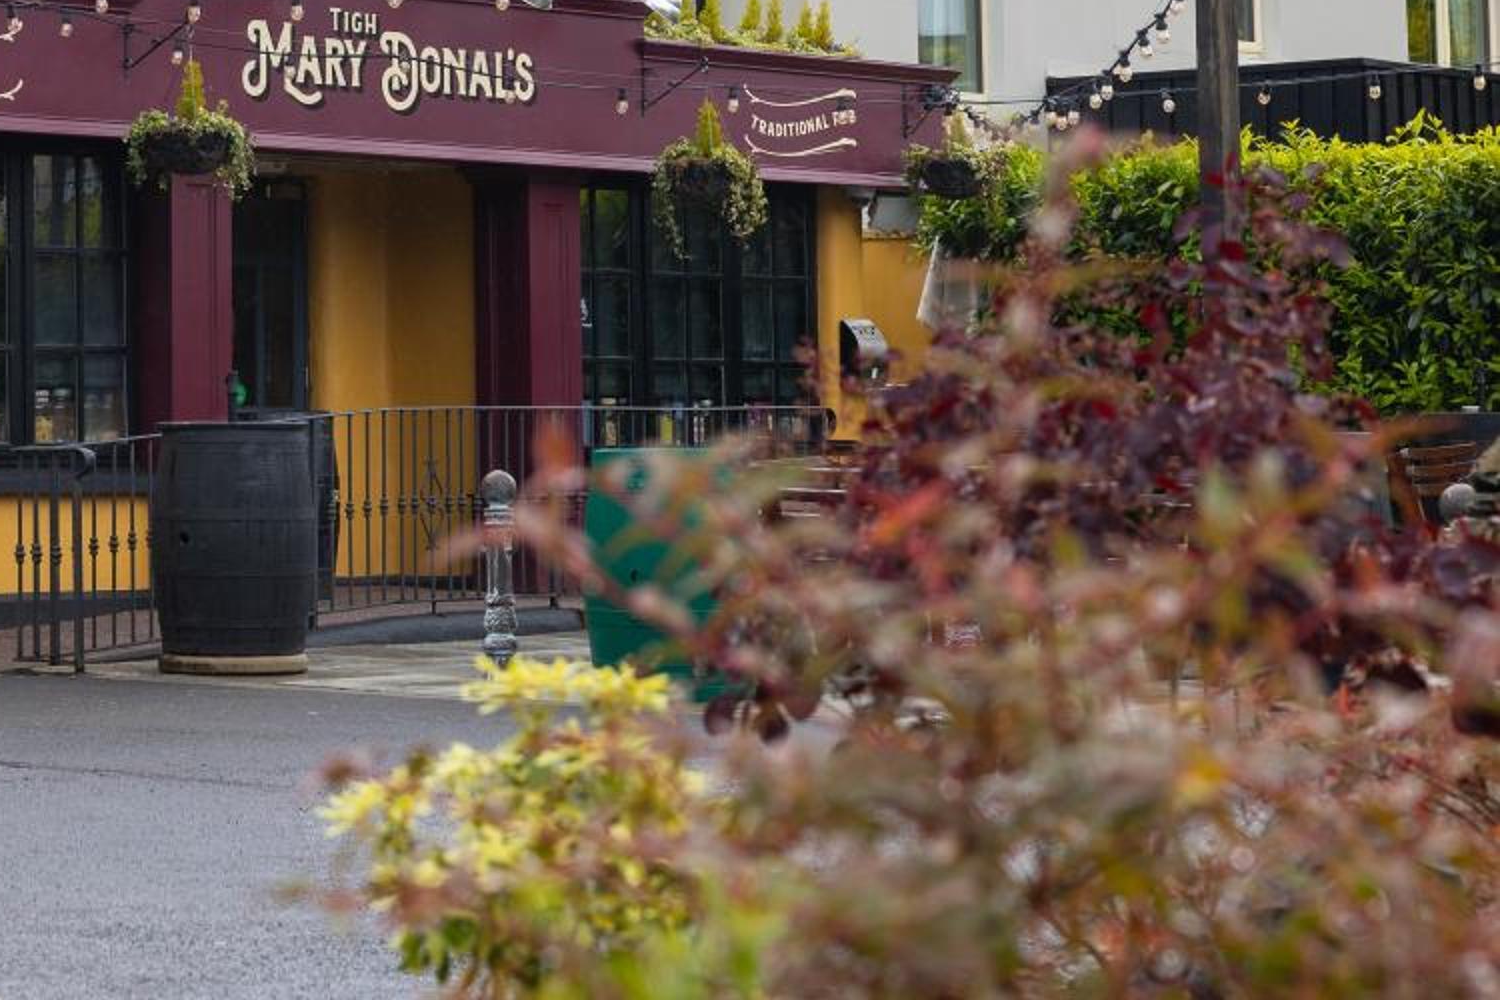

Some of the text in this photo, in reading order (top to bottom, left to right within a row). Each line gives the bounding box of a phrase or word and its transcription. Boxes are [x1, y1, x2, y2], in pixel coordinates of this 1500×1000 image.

[329, 7, 377, 34] TIGH
[242, 20, 535, 111] MARY DONAL'S
[751, 113, 829, 137] TRADITIONAL
